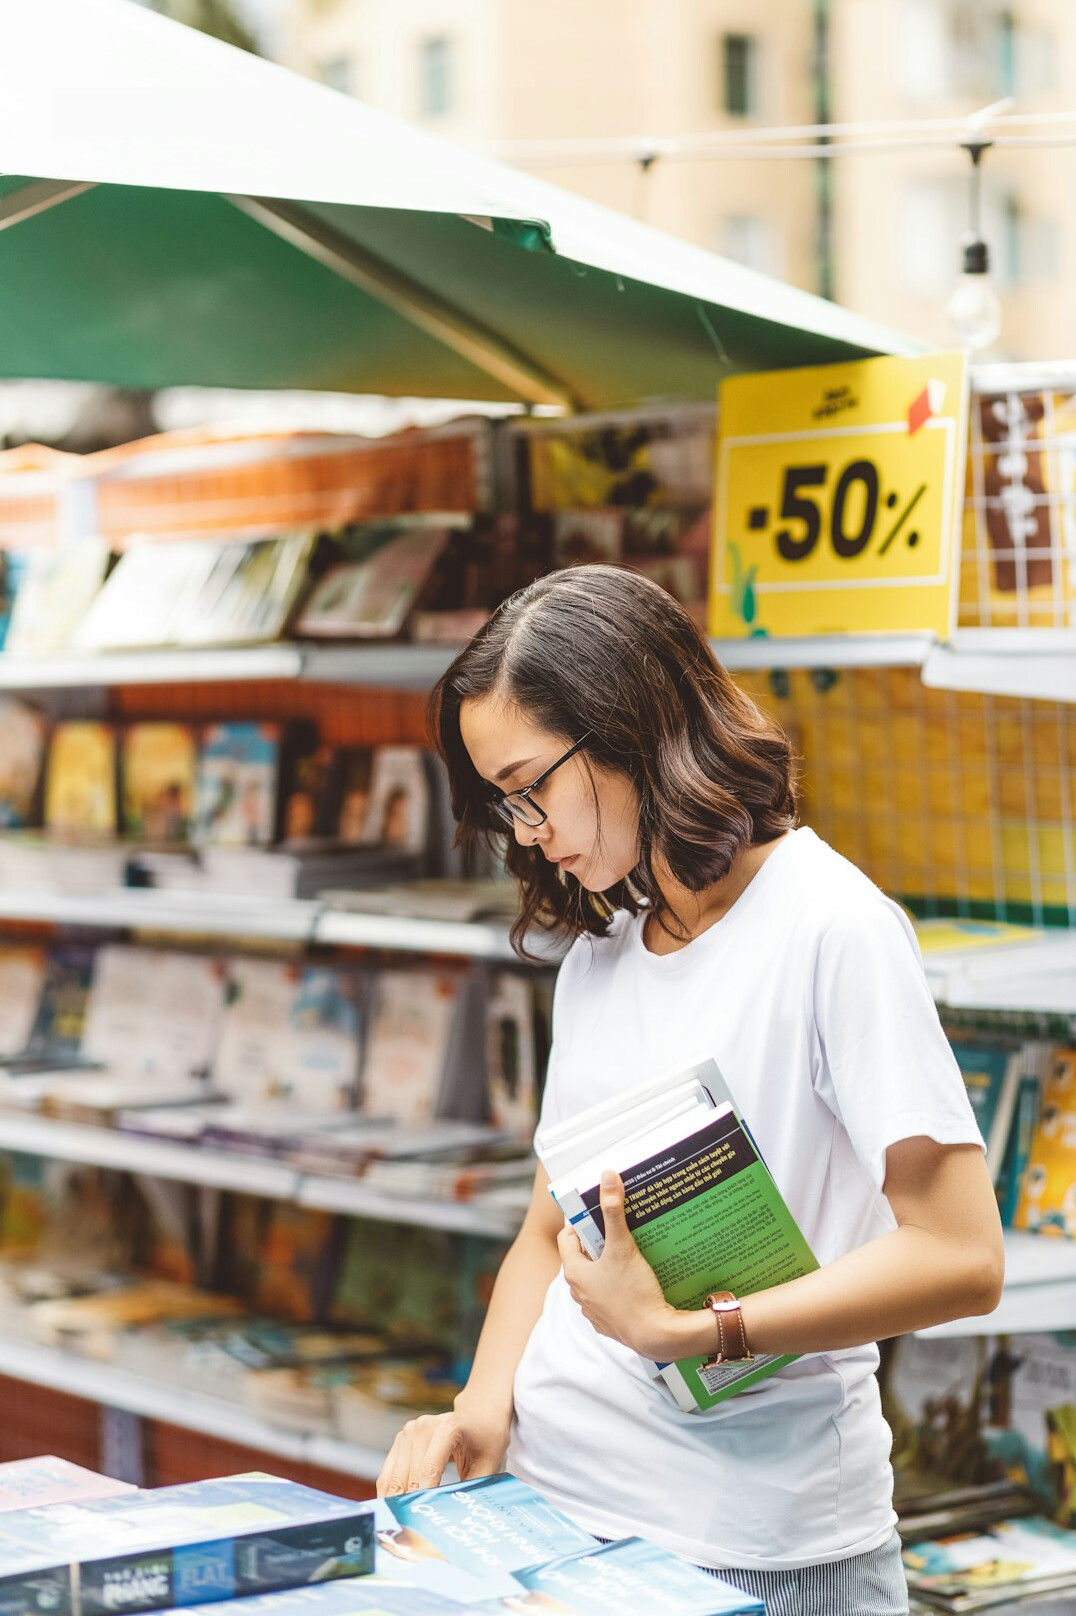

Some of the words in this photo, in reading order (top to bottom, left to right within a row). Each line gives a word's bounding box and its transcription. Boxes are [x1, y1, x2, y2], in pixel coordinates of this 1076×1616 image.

[747, 459, 927, 561] -50%
[628, 1188, 647, 1202] TRUMP
[672, 1169, 687, 1179] trong
